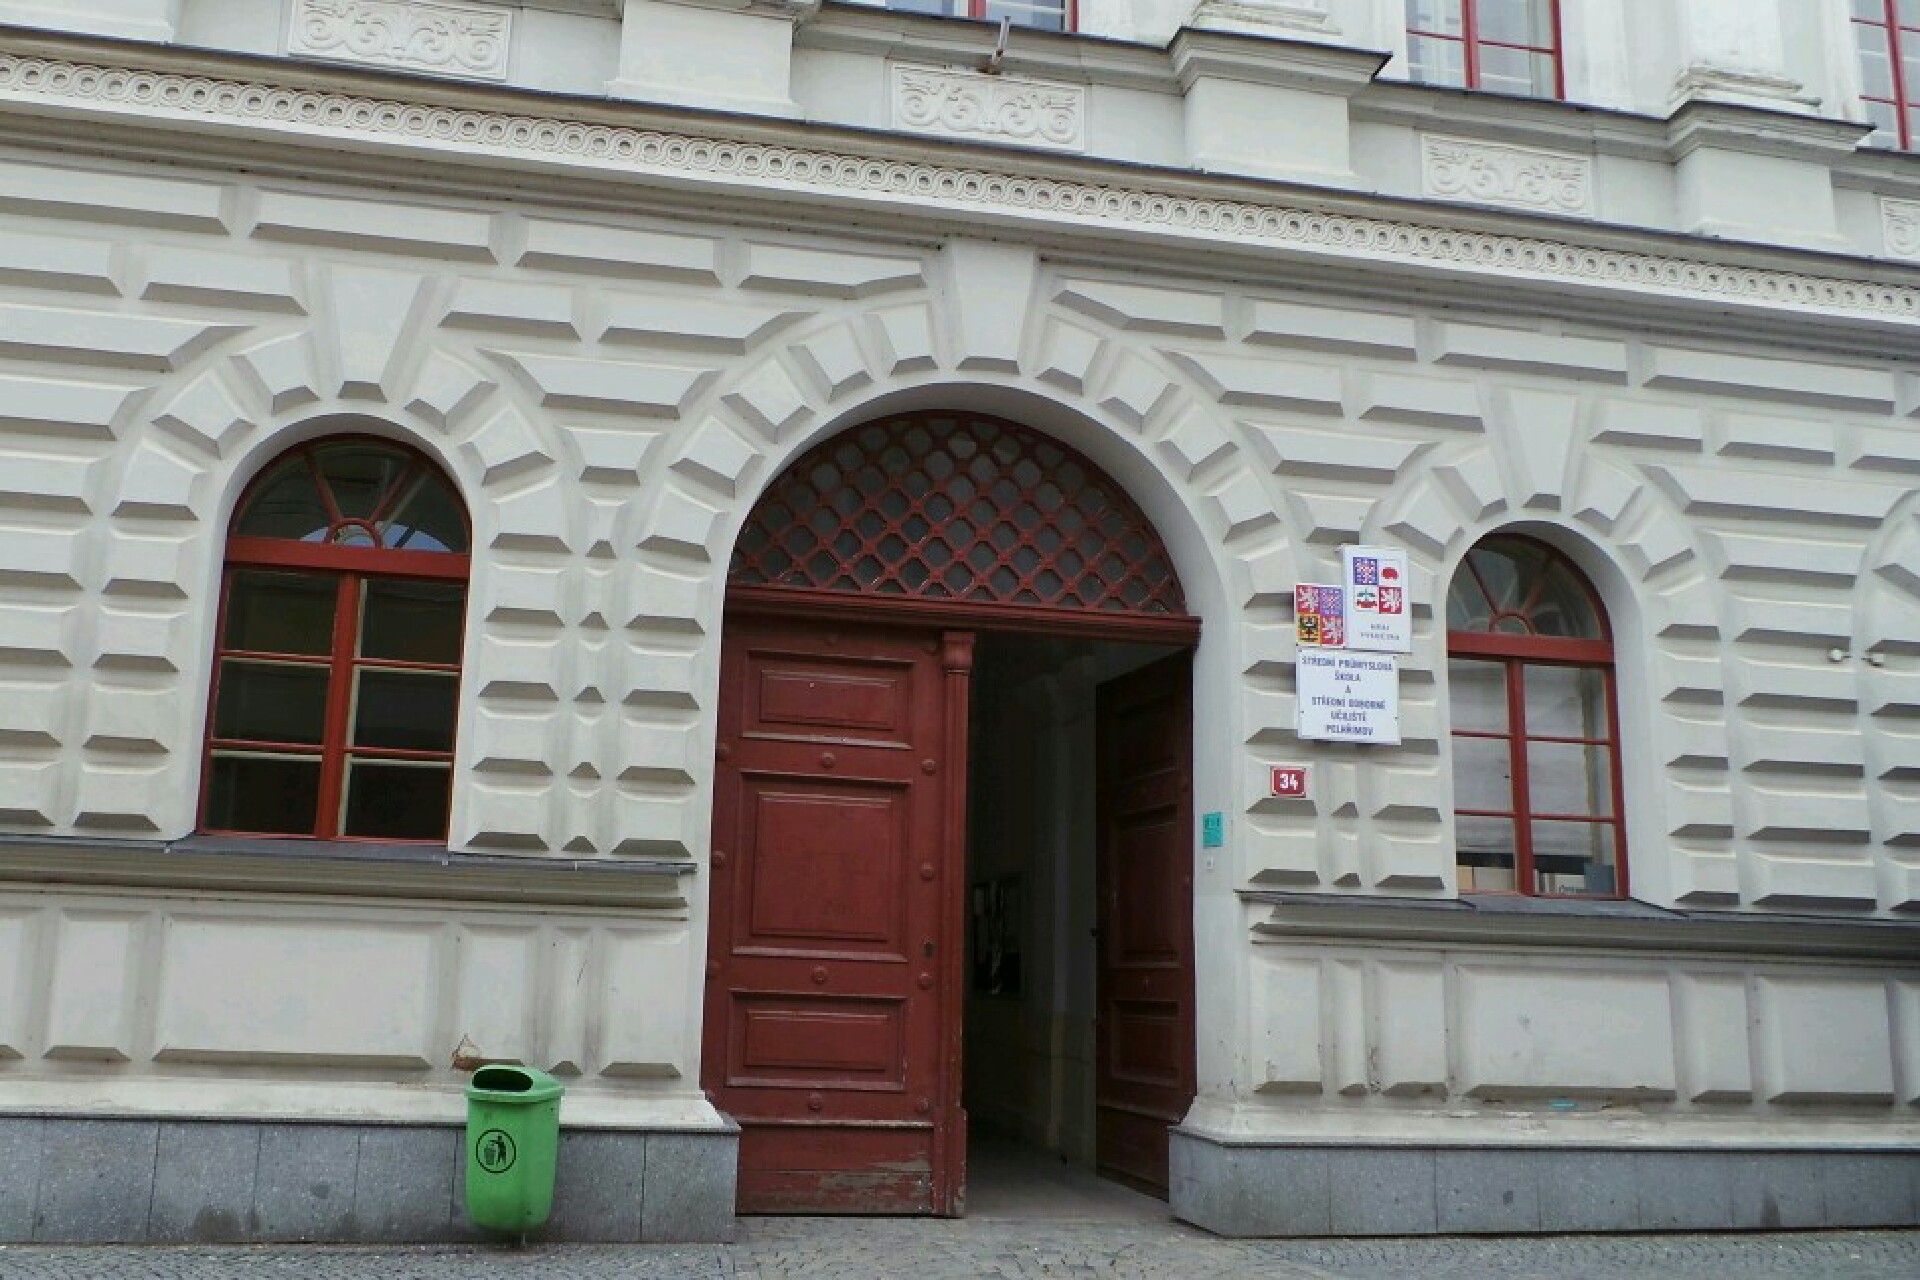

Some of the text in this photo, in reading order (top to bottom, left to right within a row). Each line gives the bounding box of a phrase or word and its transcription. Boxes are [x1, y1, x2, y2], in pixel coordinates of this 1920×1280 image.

[1301, 655, 1336, 667] STŘEDNÍ
[1334, 670, 1361, 681] ŠKOLA
[1344, 684, 1352, 694] A
[1311, 695, 1346, 707] STŘEDNÍ
[1325, 723, 1374, 736] PELHŘIMOV
[1279, 772, 1299, 790] 34
